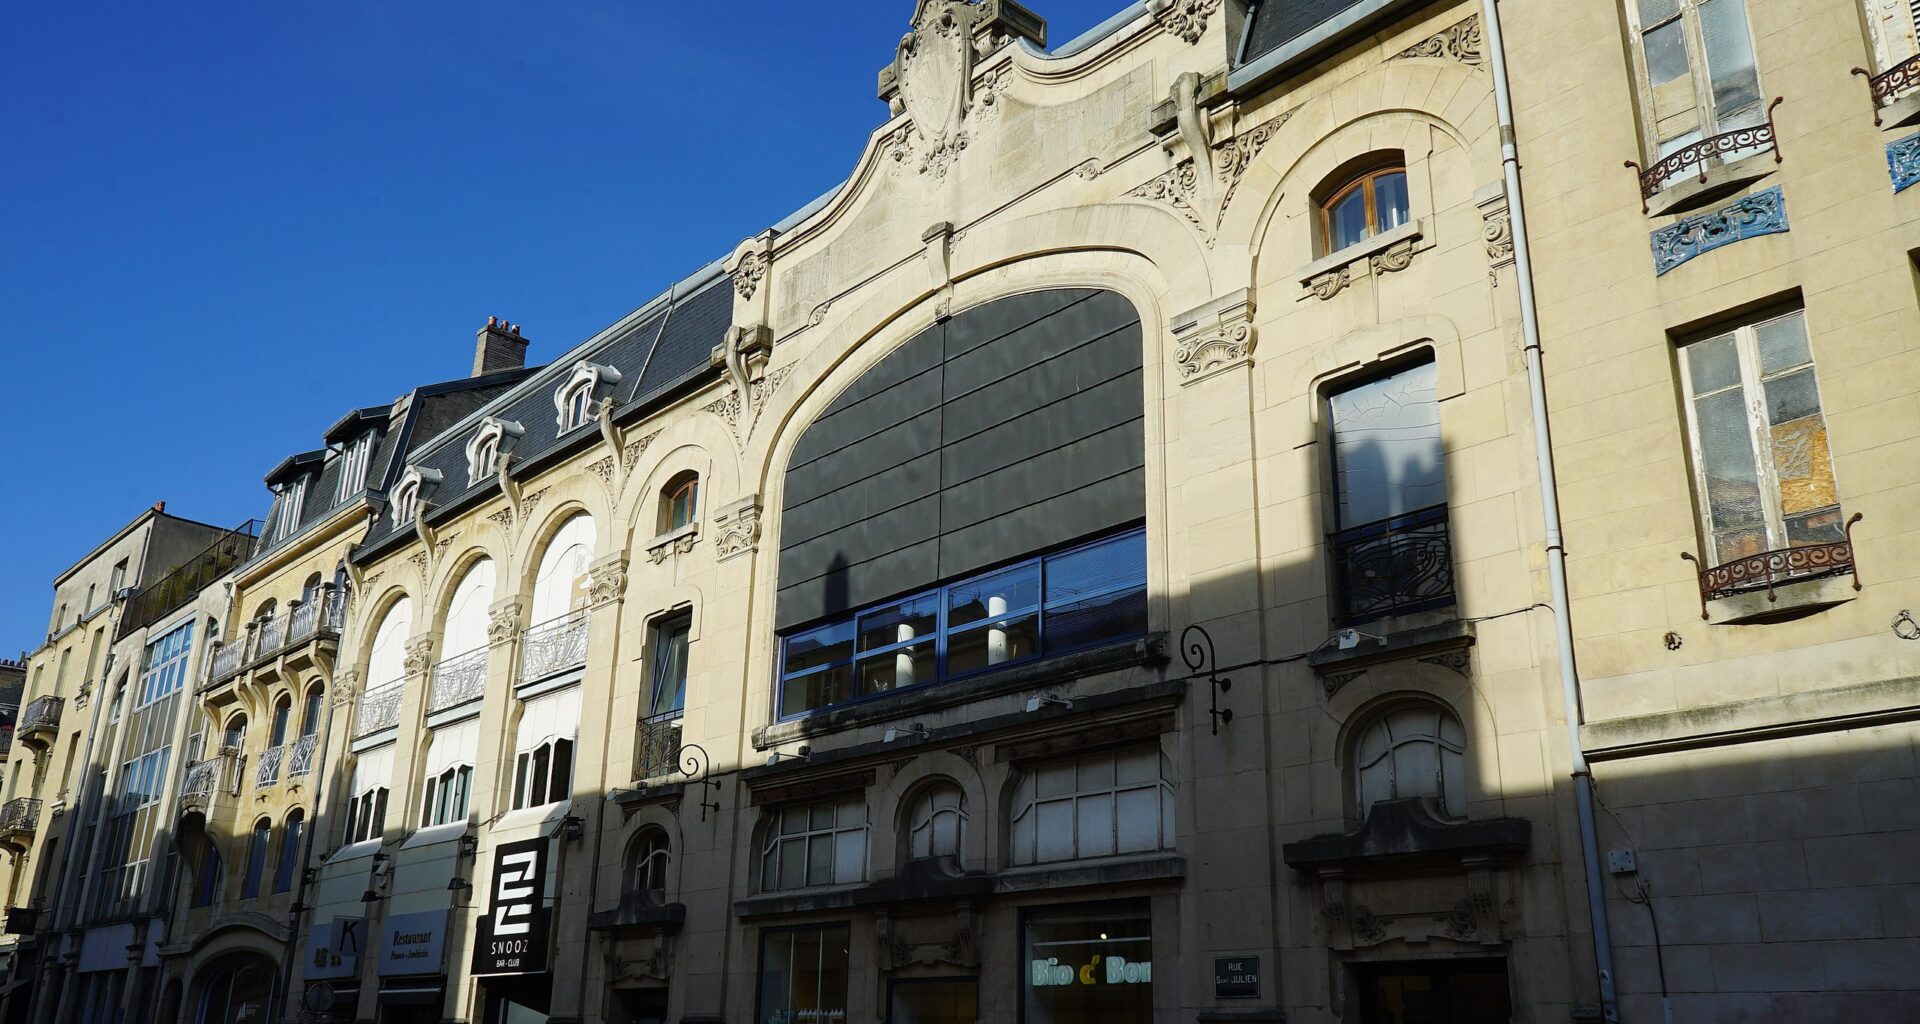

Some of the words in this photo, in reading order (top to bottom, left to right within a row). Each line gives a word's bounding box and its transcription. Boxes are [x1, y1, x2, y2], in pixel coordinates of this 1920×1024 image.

[393, 931, 432, 946] Restaurant
[491, 939, 529, 955] SNOOZ
[1031, 956, 1075, 986] Bio
[1228, 962, 1243, 971] RUE
[1231, 974, 1257, 984] JULIEN
